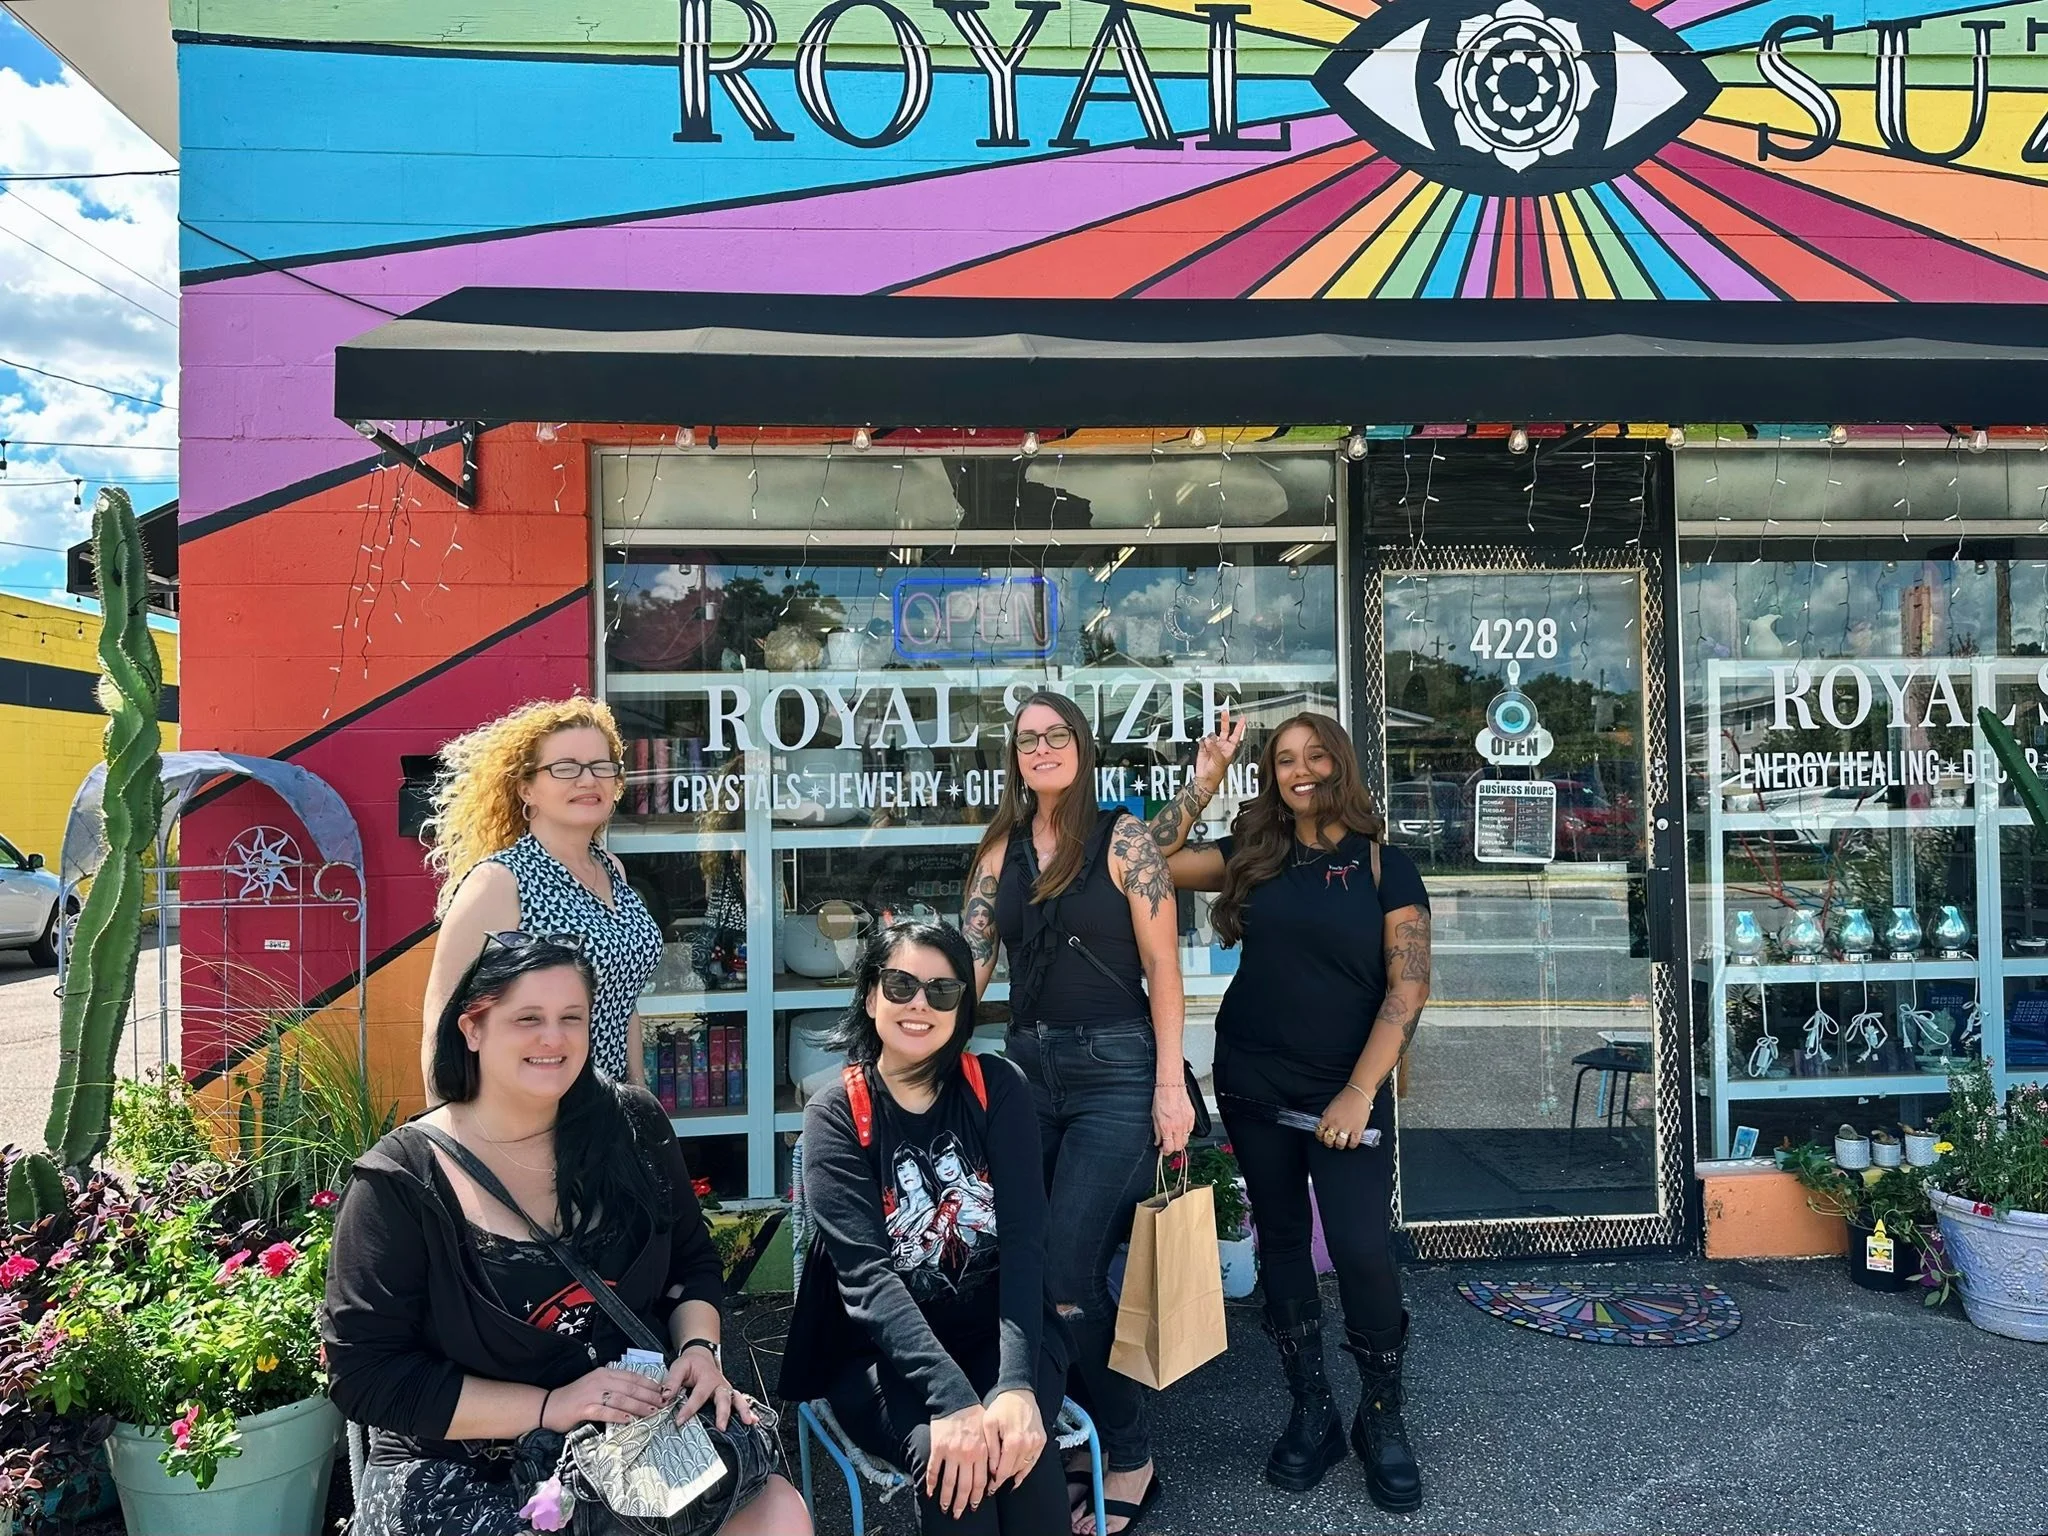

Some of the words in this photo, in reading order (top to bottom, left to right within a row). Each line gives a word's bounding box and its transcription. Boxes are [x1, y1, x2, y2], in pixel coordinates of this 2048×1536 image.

[673, 0, 1291, 151] ROYAL
[902, 591, 1049, 645] OPEN
[1469, 617, 1558, 660] 4228
[701, 683, 979, 751] ROYAL
[1767, 663, 2016, 730] ROYAL
[1491, 736, 1539, 757] OPEN
[1480, 785, 1523, 795] BUSINESS
[1524, 786, 1554, 796] HOURS
[1740, 751, 1833, 789] ENERGY
[1840, 750, 1941, 789] HEALING
[673, 772, 801, 813] CRYSTALS
[825, 770, 943, 809] JEWELRY
